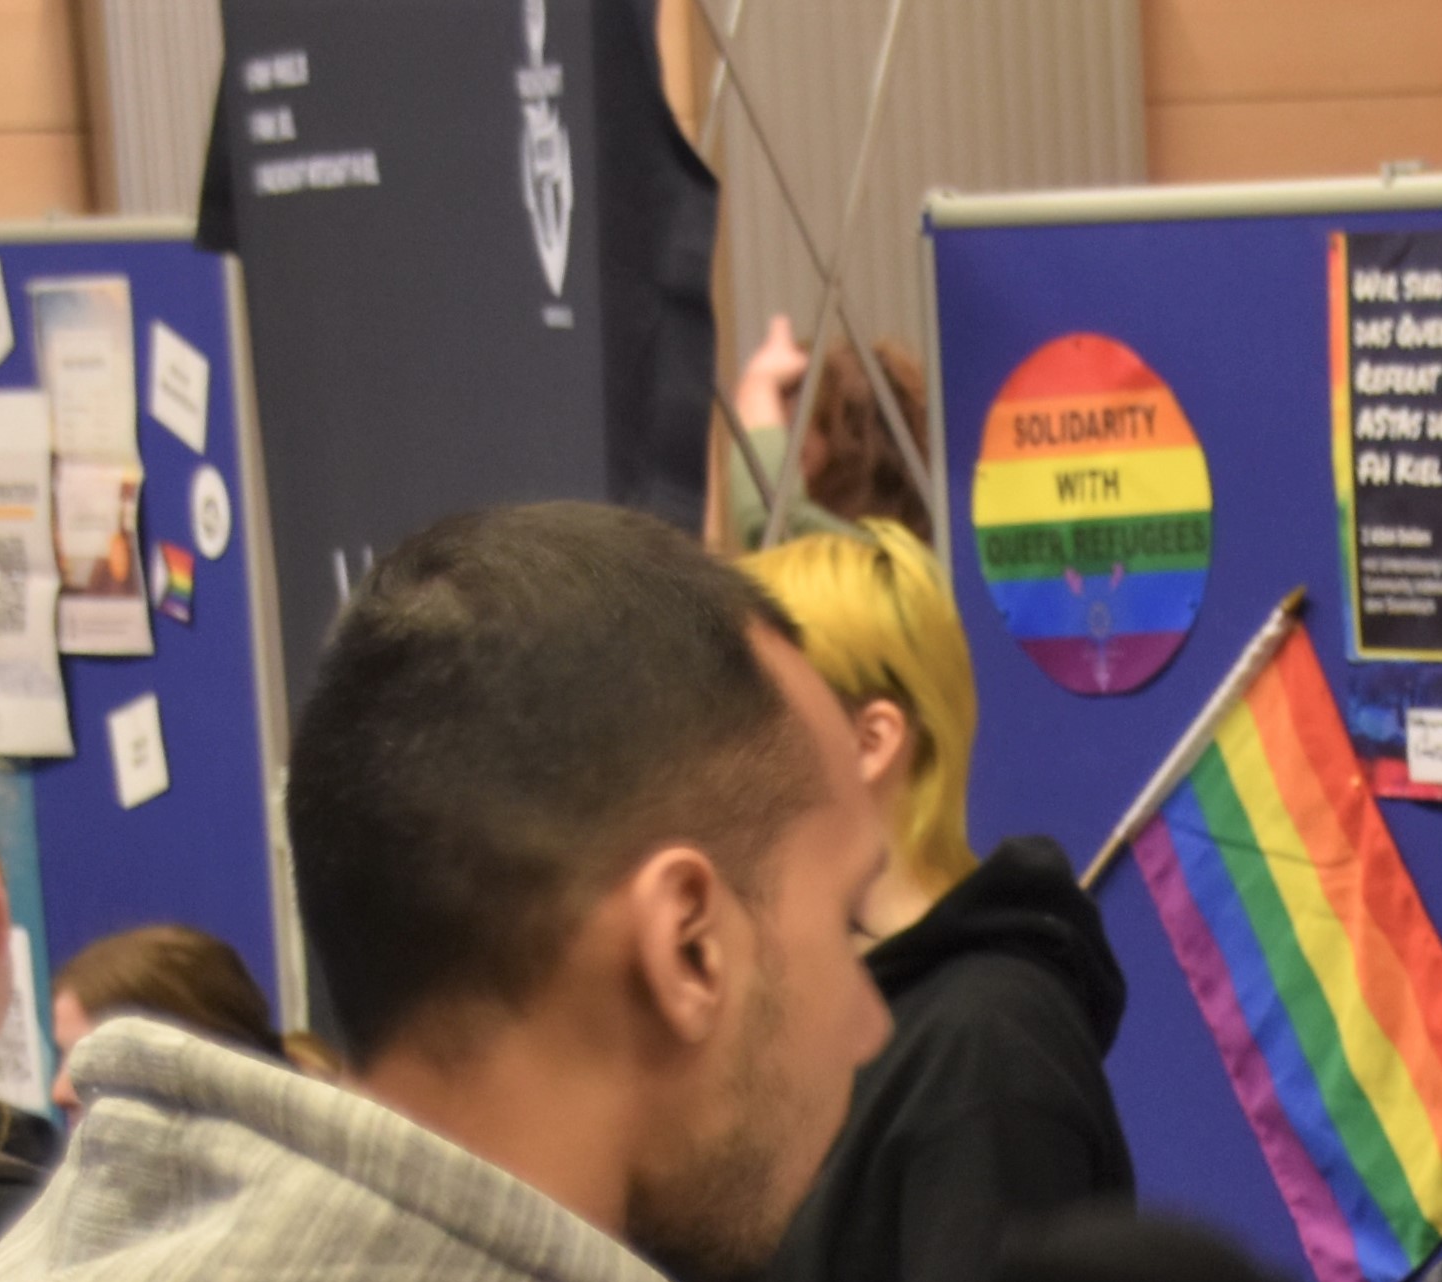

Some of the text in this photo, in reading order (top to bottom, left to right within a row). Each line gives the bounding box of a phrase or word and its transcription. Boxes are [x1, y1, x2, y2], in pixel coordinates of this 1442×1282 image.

[1014, 404, 1158, 448] SOLIDARITY
[1054, 468, 1121, 502] WITH
[985, 519, 1207, 568] QUEER REFUGEES
